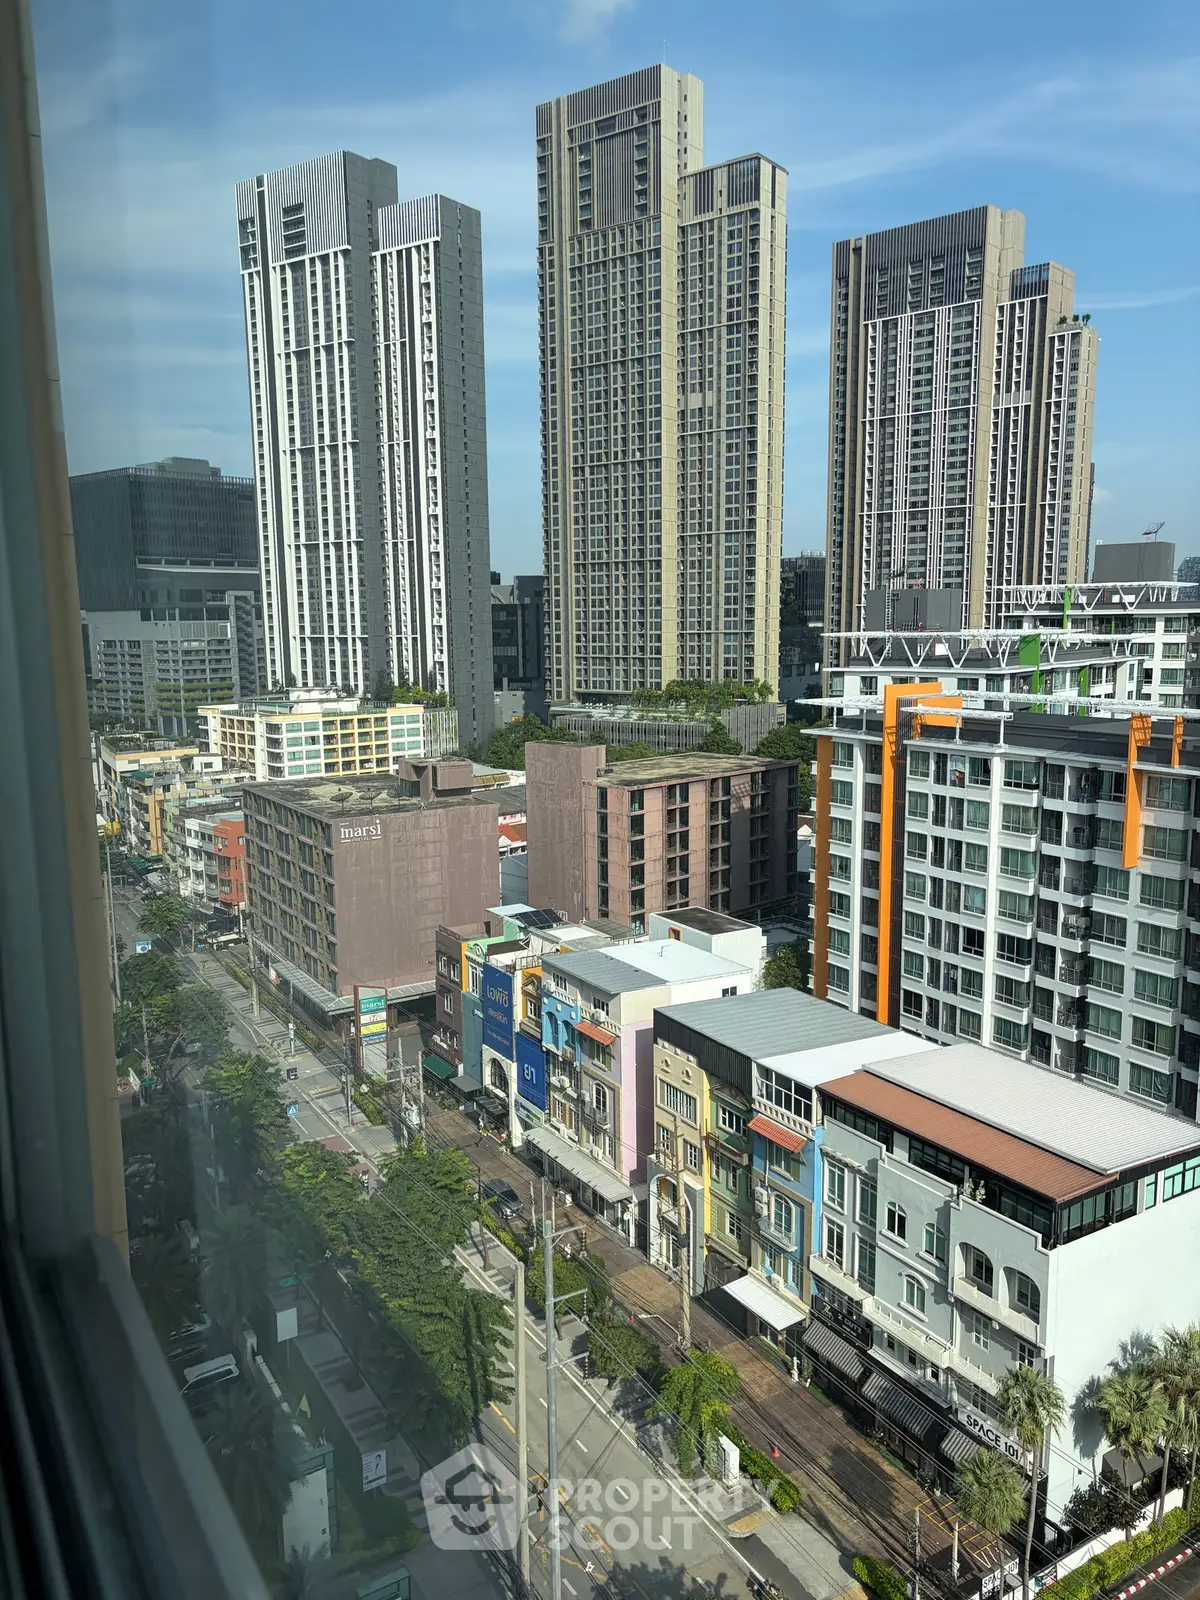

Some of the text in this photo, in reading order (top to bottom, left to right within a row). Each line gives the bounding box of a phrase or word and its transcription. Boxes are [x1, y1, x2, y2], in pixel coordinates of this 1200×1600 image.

[340, 819, 382, 838] marsi
[361, 1000, 385, 1010] marsi
[523, 1063, 536, 1085] ยา
[965, 1414, 1019, 1460] SPACE 101
[983, 1567, 1005, 1589] SPAC
